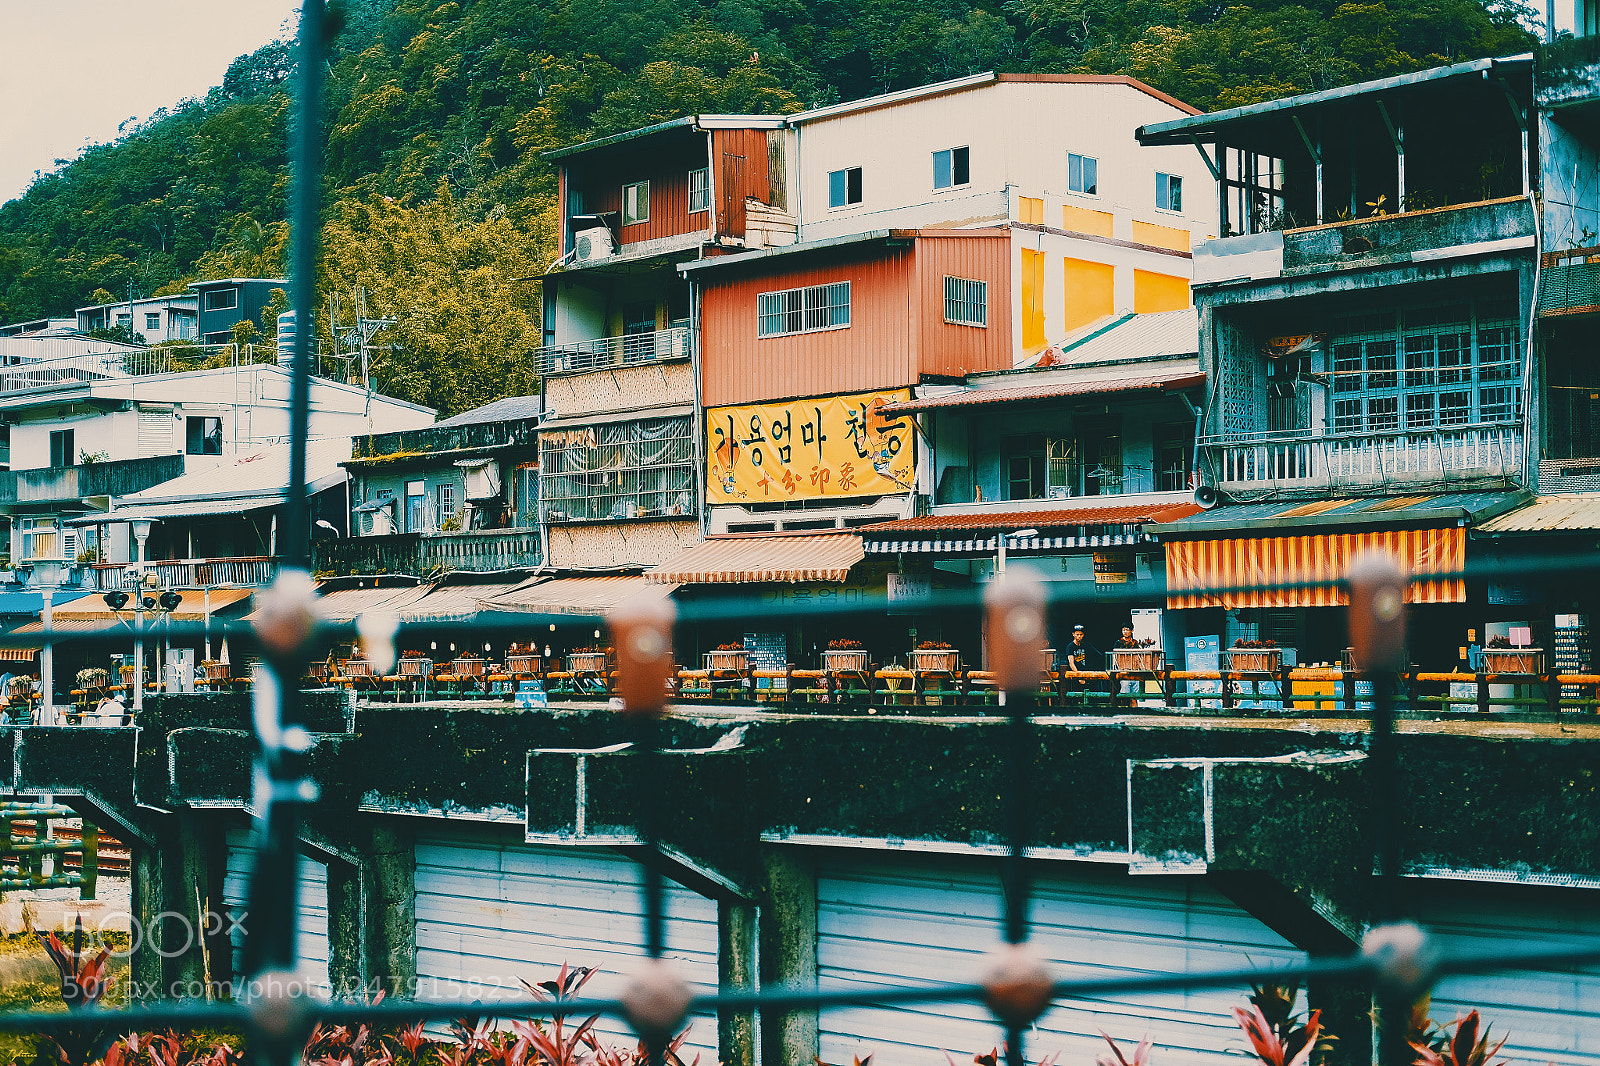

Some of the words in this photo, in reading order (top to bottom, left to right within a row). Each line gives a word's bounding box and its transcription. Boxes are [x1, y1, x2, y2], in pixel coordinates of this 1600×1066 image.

[714, 407, 827, 469] 가용엄마
[756, 461, 858, 496] 十分印象
[763, 587, 868, 605] 가용엄마
